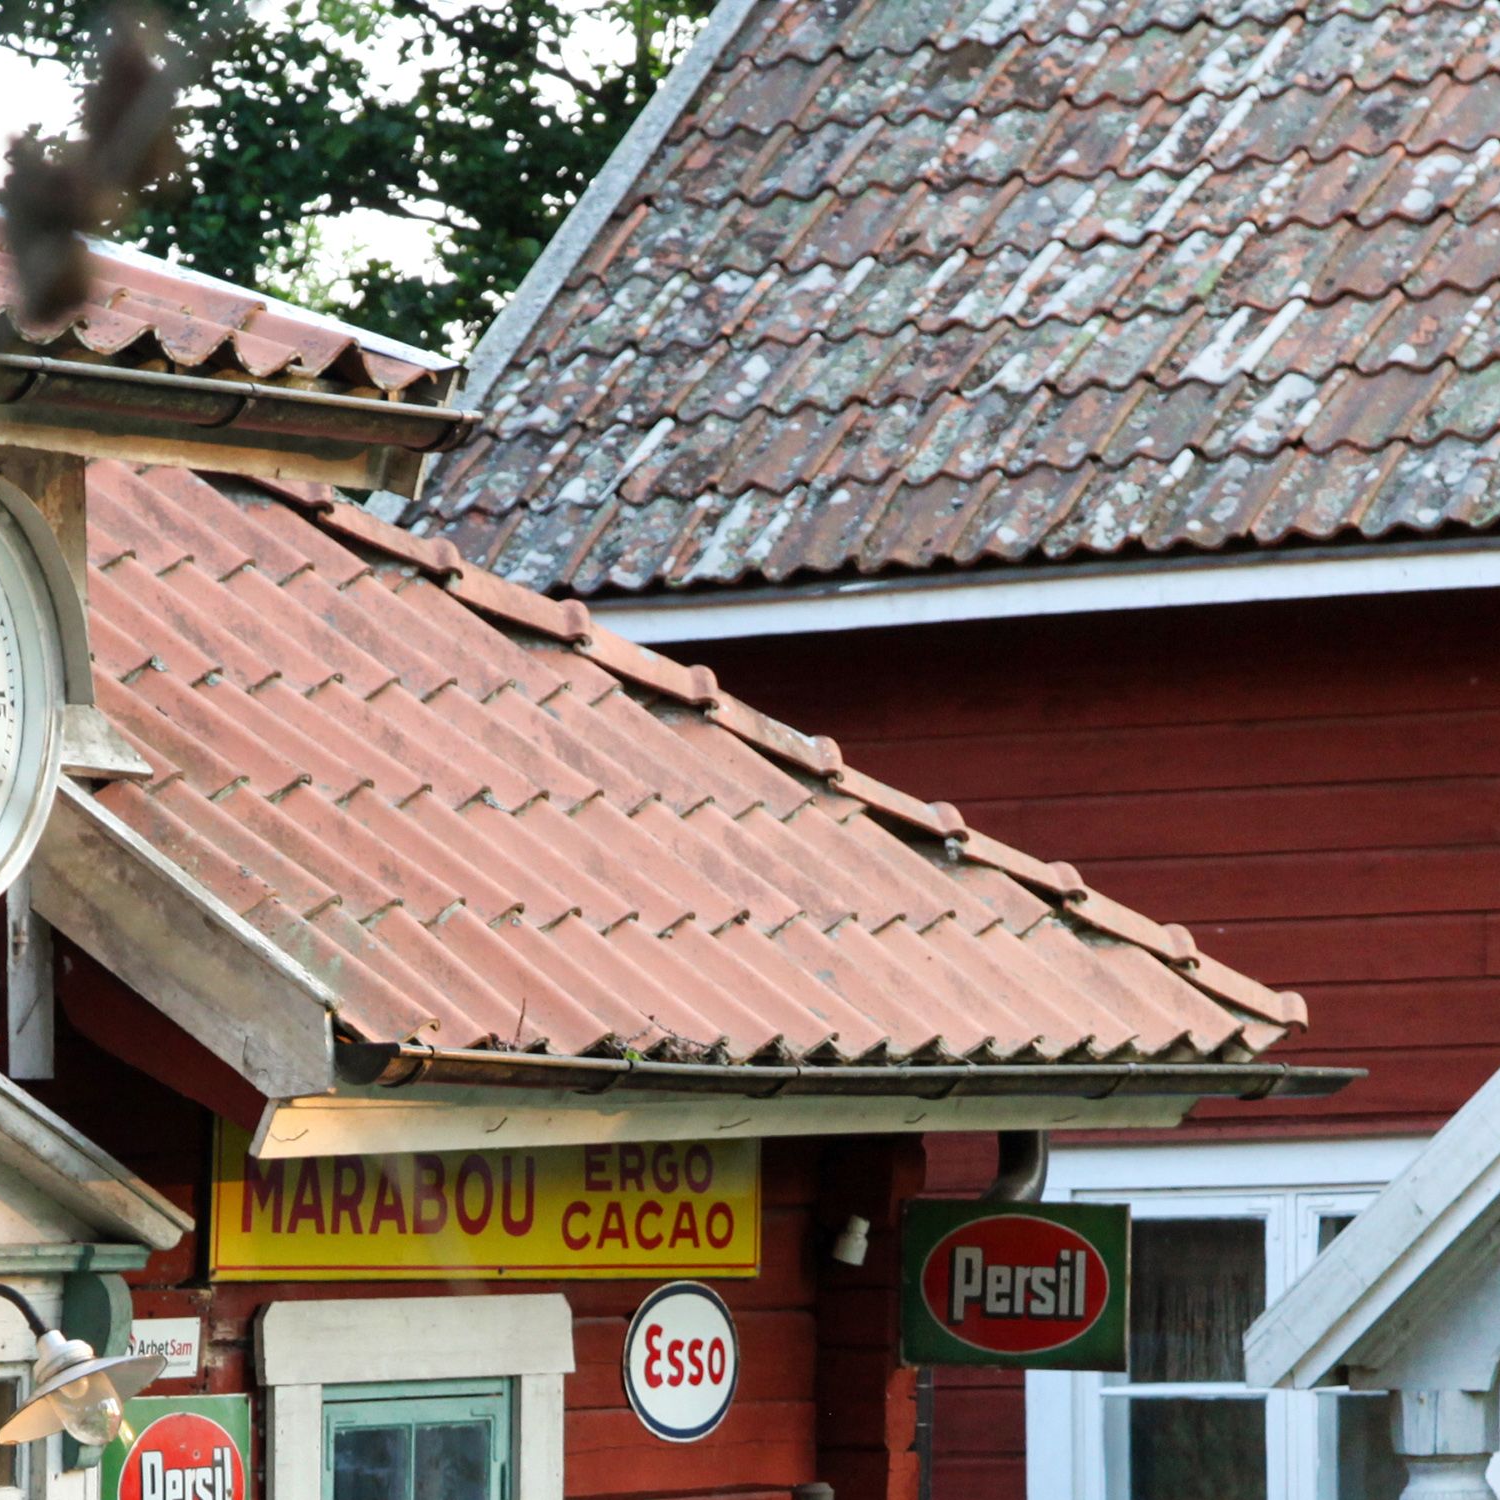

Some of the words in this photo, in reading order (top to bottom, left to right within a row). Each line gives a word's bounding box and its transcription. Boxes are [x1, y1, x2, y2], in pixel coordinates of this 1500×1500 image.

[240, 1154, 536, 1237] MARABOU
[583, 1143, 715, 1194] ERGO
[561, 1201, 735, 1251] CACAO
[952, 1246, 1087, 1321] Persil
